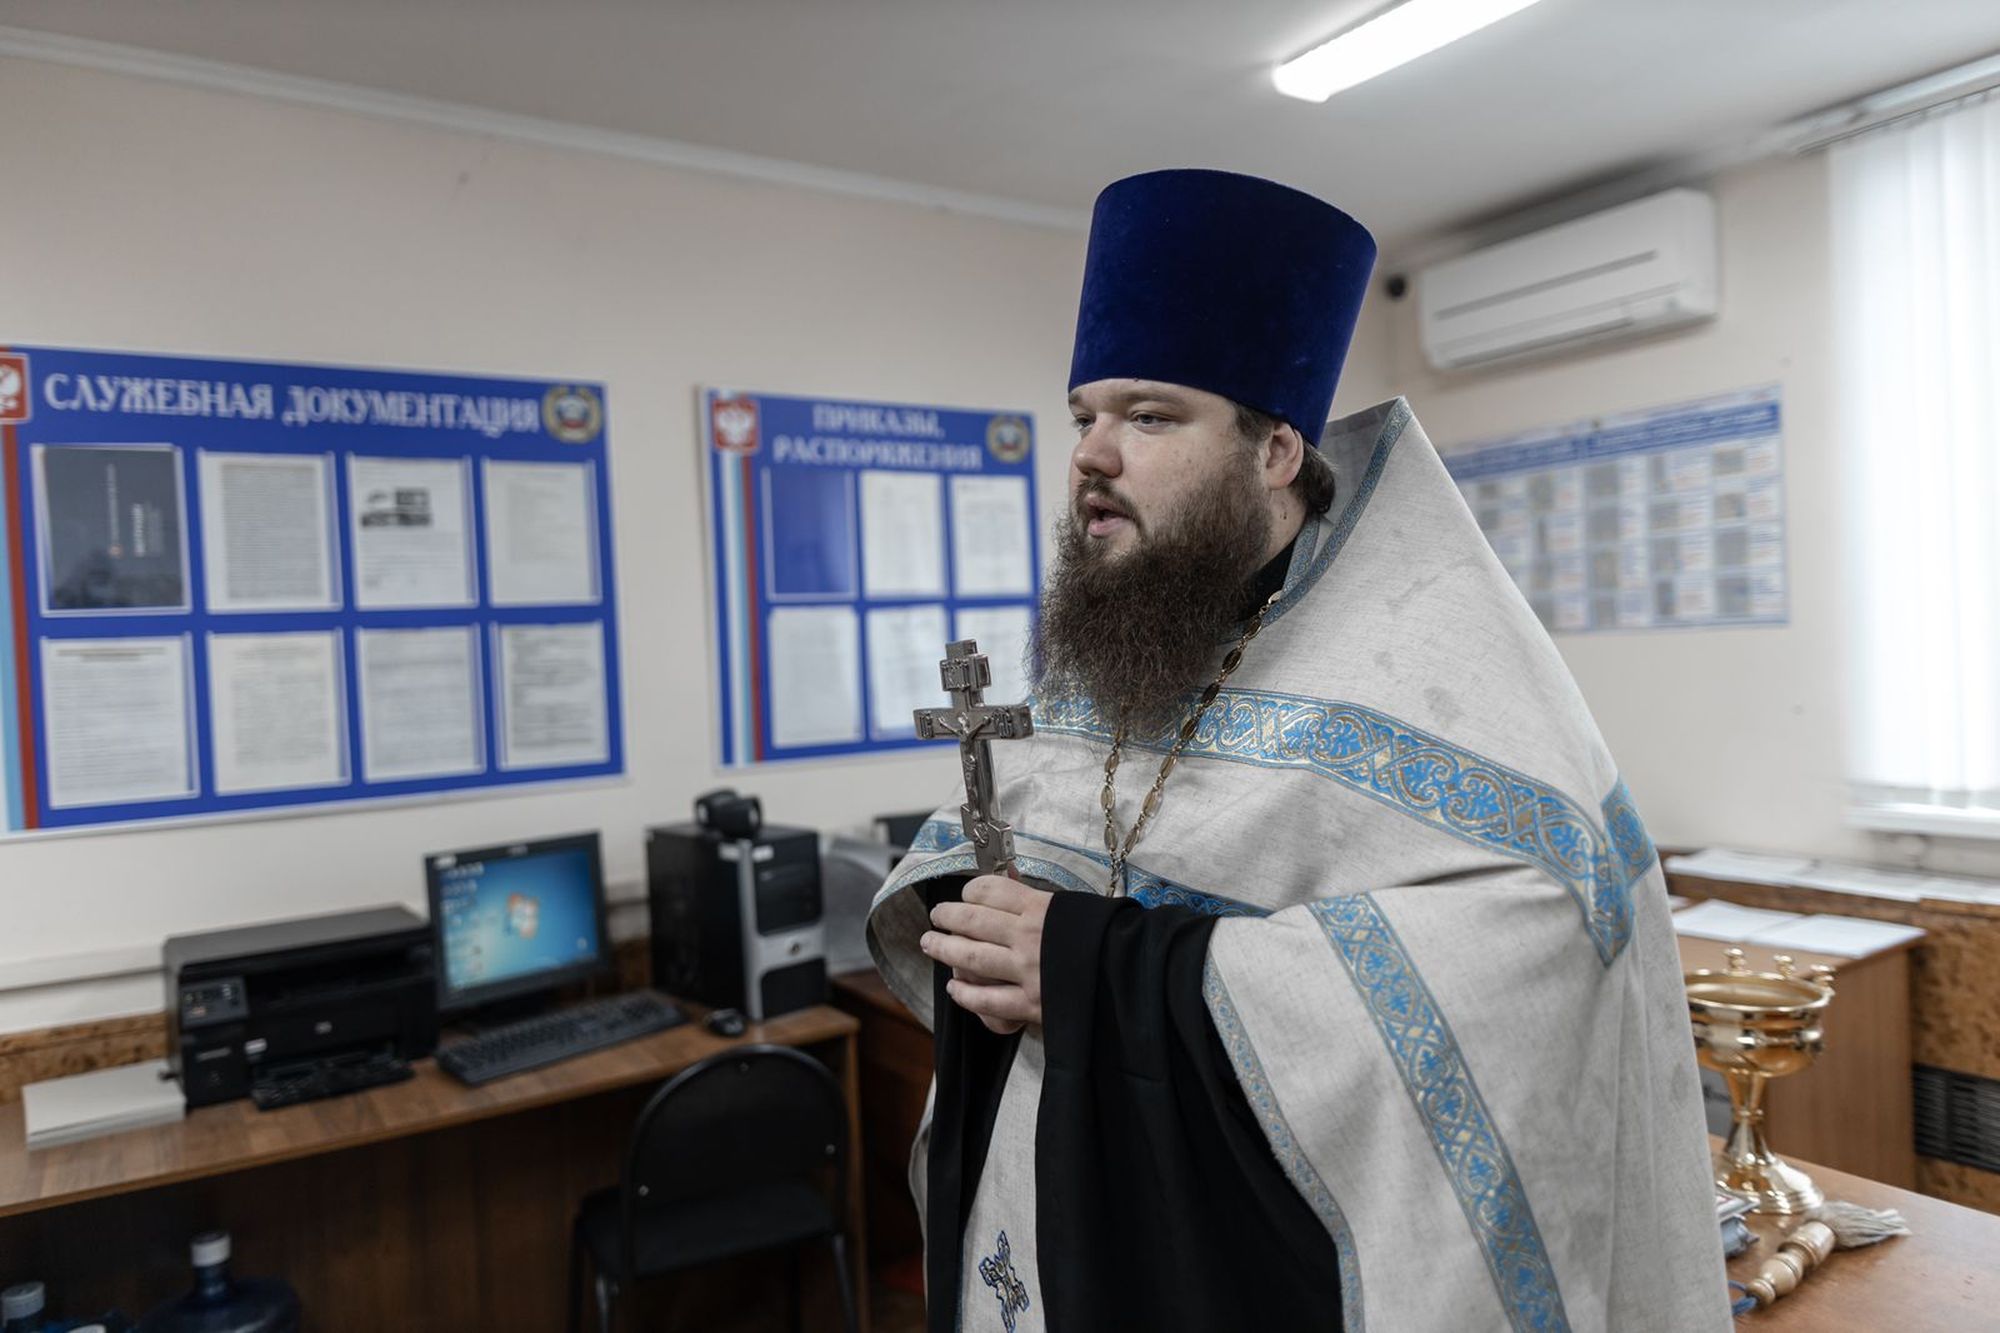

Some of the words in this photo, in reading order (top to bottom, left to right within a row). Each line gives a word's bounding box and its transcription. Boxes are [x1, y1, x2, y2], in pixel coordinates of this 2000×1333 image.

[44, 373, 274, 420] СЛУЖЕБНАЯ
[281, 385, 540, 438] ДОКУМЕНТАЦИЯ
[772, 434, 983, 470] РАСПОРЯЖЕНИЯ
